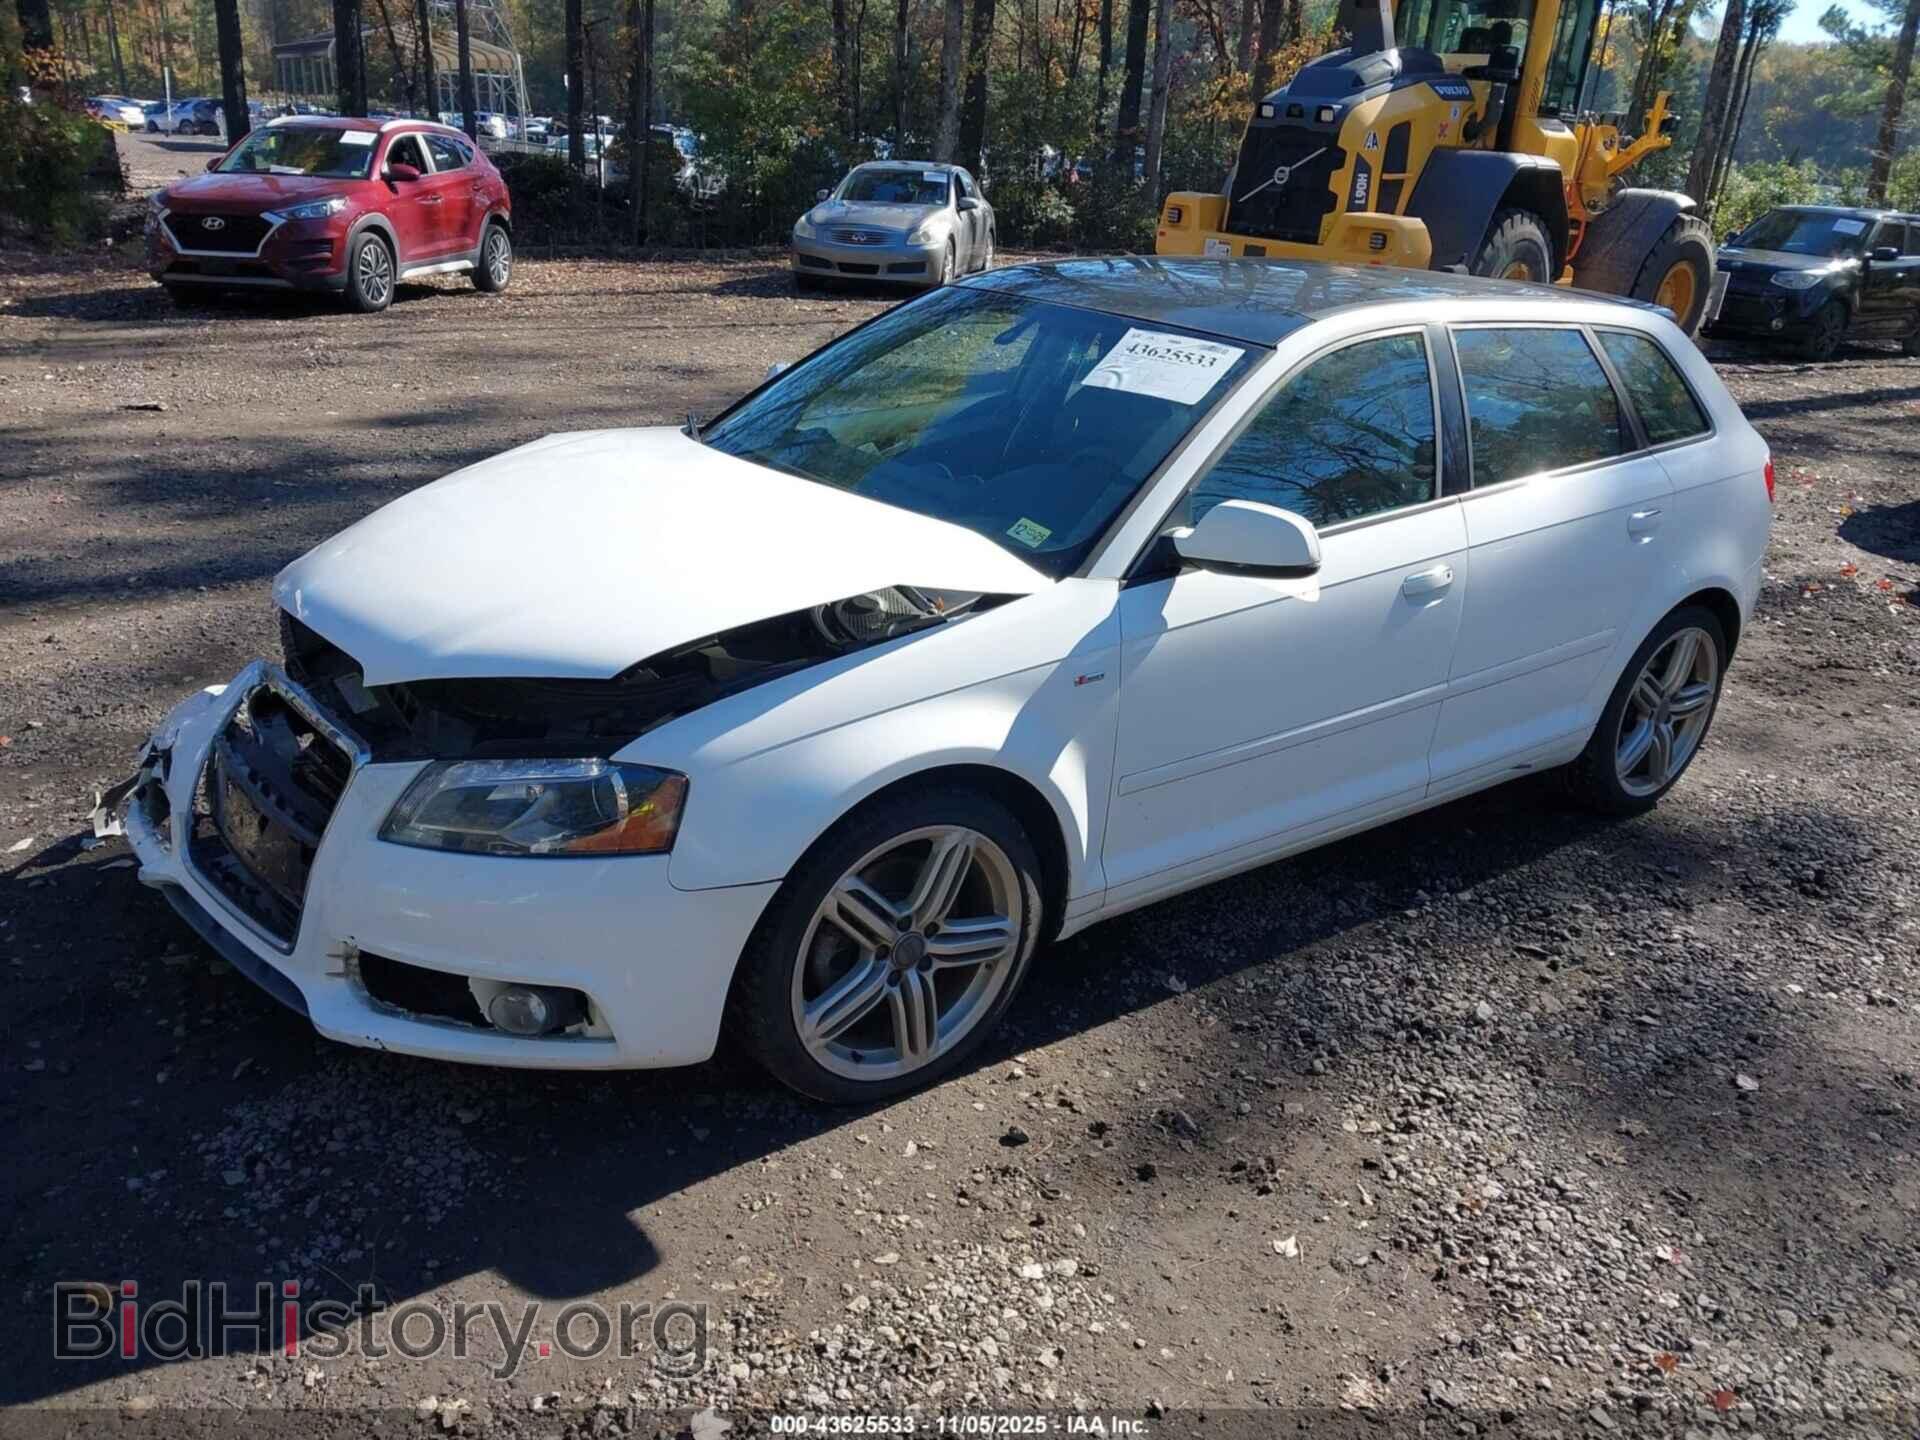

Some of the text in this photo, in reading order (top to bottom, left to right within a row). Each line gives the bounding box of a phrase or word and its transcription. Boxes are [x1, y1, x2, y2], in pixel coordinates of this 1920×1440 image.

[1434, 86, 1470, 96] VOLVO
[1354, 173, 1368, 204] L90H
[1125, 343, 1218, 368] 43625533
